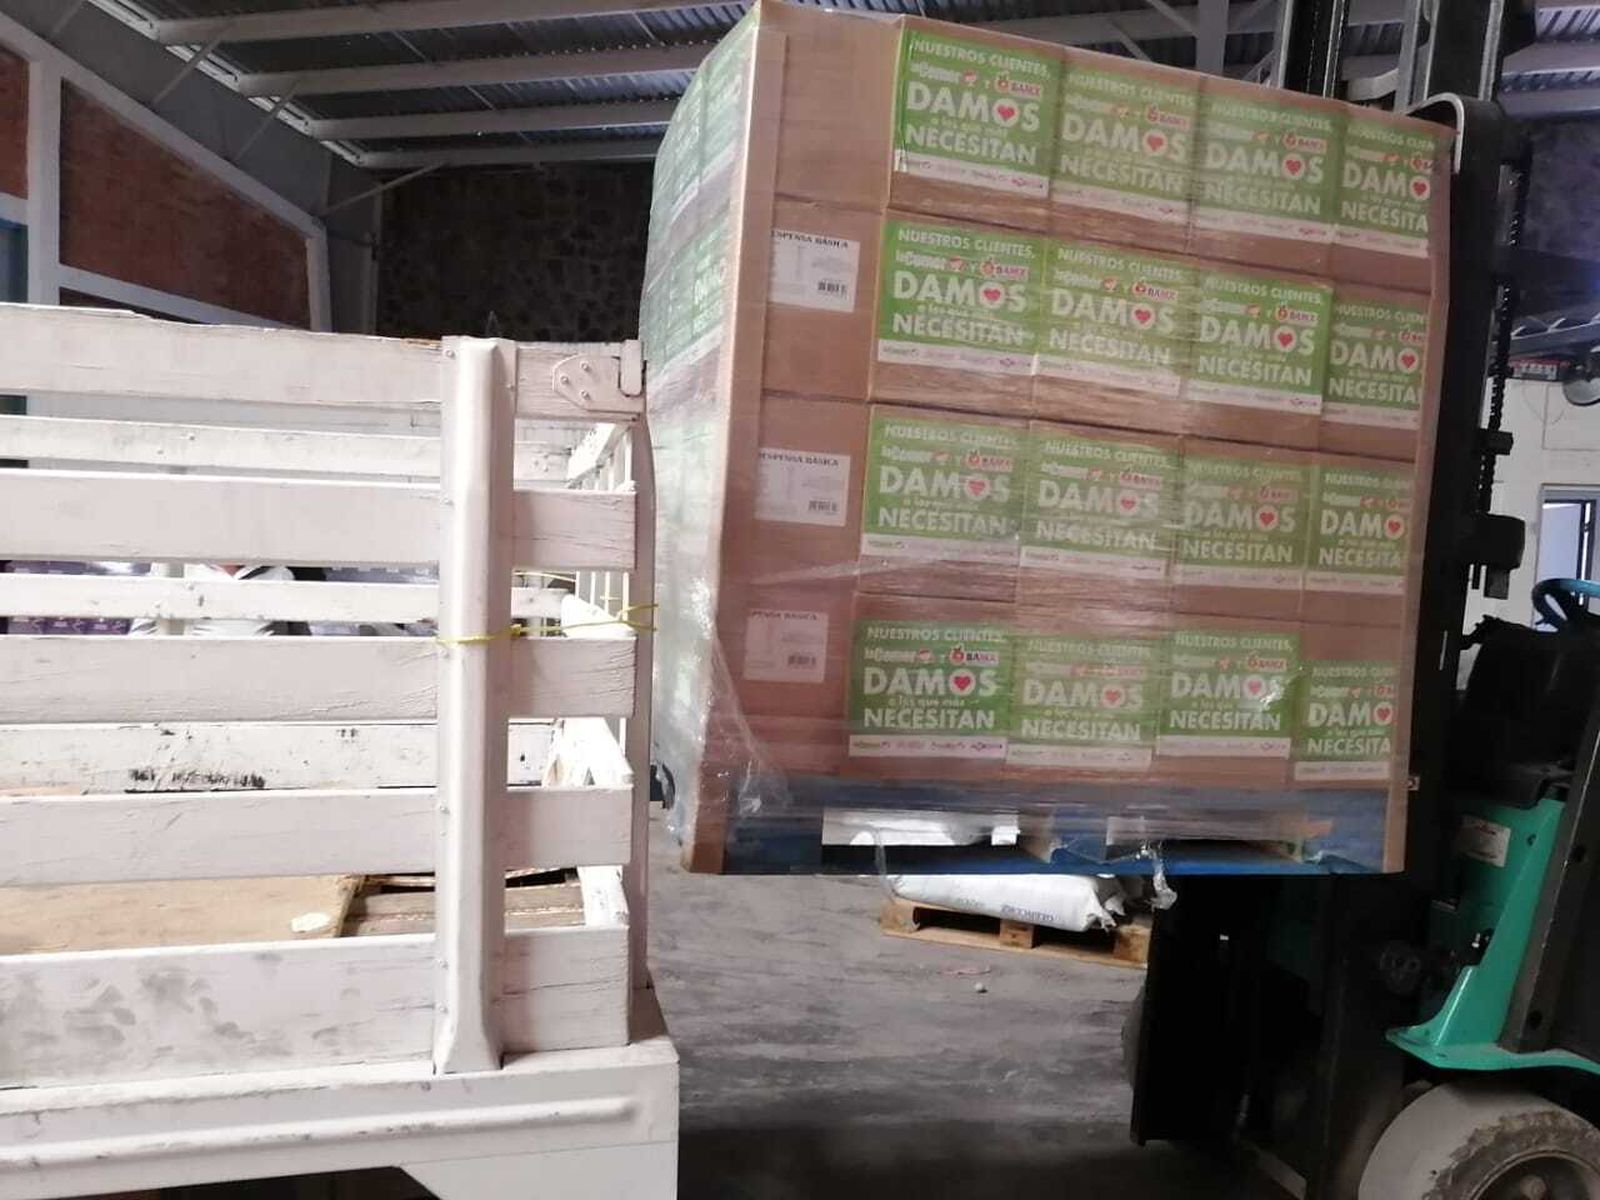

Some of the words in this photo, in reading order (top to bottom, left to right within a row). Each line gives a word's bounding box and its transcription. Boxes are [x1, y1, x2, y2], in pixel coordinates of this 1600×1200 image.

[914, 39, 987, 64] NUESTROS
[907, 81, 1040, 132] DAMOS
[905, 123, 1037, 165] NECESITAN
[1062, 113, 1187, 162] DAMOS
[1060, 154, 1184, 192] NECESITAN
[1205, 142, 1323, 184] DAMOS
[1343, 160, 1430, 201] DAMO
[1204, 181, 1320, 214] NECESITAN
[1341, 200, 1429, 233] NECESITA
[898, 229, 970, 250] NUESTROS
[1057, 247, 1124, 270] NUESTROS
[893, 270, 1027, 313] DAMOS
[1203, 276, 1268, 297] NUESTROS
[1051, 287, 1175, 335] DAMOS
[892, 313, 1024, 345] NECESITAN
[1200, 315, 1315, 356] DAMOS
[1050, 327, 1171, 364] NECESITAN
[1329, 339, 1420, 374] DAMO
[1198, 355, 1312, 386] NECESITAN
[1328, 377, 1417, 403] NECESITA
[885, 423, 955, 442] NUESTROS
[879, 464, 1011, 502] DAMOS
[1038, 479, 1160, 518] DAMOS
[878, 507, 1008, 536] NECESITAN
[1183, 500, 1297, 533] DAMOS
[1320, 509, 1405, 540] DAMO
[1036, 519, 1157, 549] NECESITAN
[1181, 538, 1293, 562] NECESITAN
[1319, 547, 1401, 569] NECESITA
[866, 626, 940, 641] NUESTROS
[1174, 630, 1237, 648] NUESTROS
[863, 666, 998, 697] DAMOS
[1022, 678, 1144, 712] DAMOS
[1170, 670, 1285, 699] DAMOS
[863, 708, 996, 730] NECESITAN
[1021, 718, 1142, 741] NECESITAN
[1169, 709, 1281, 731] NECESITAN
[1307, 701, 1394, 728] DAMO
[1306, 737, 1392, 756] NECESITA
